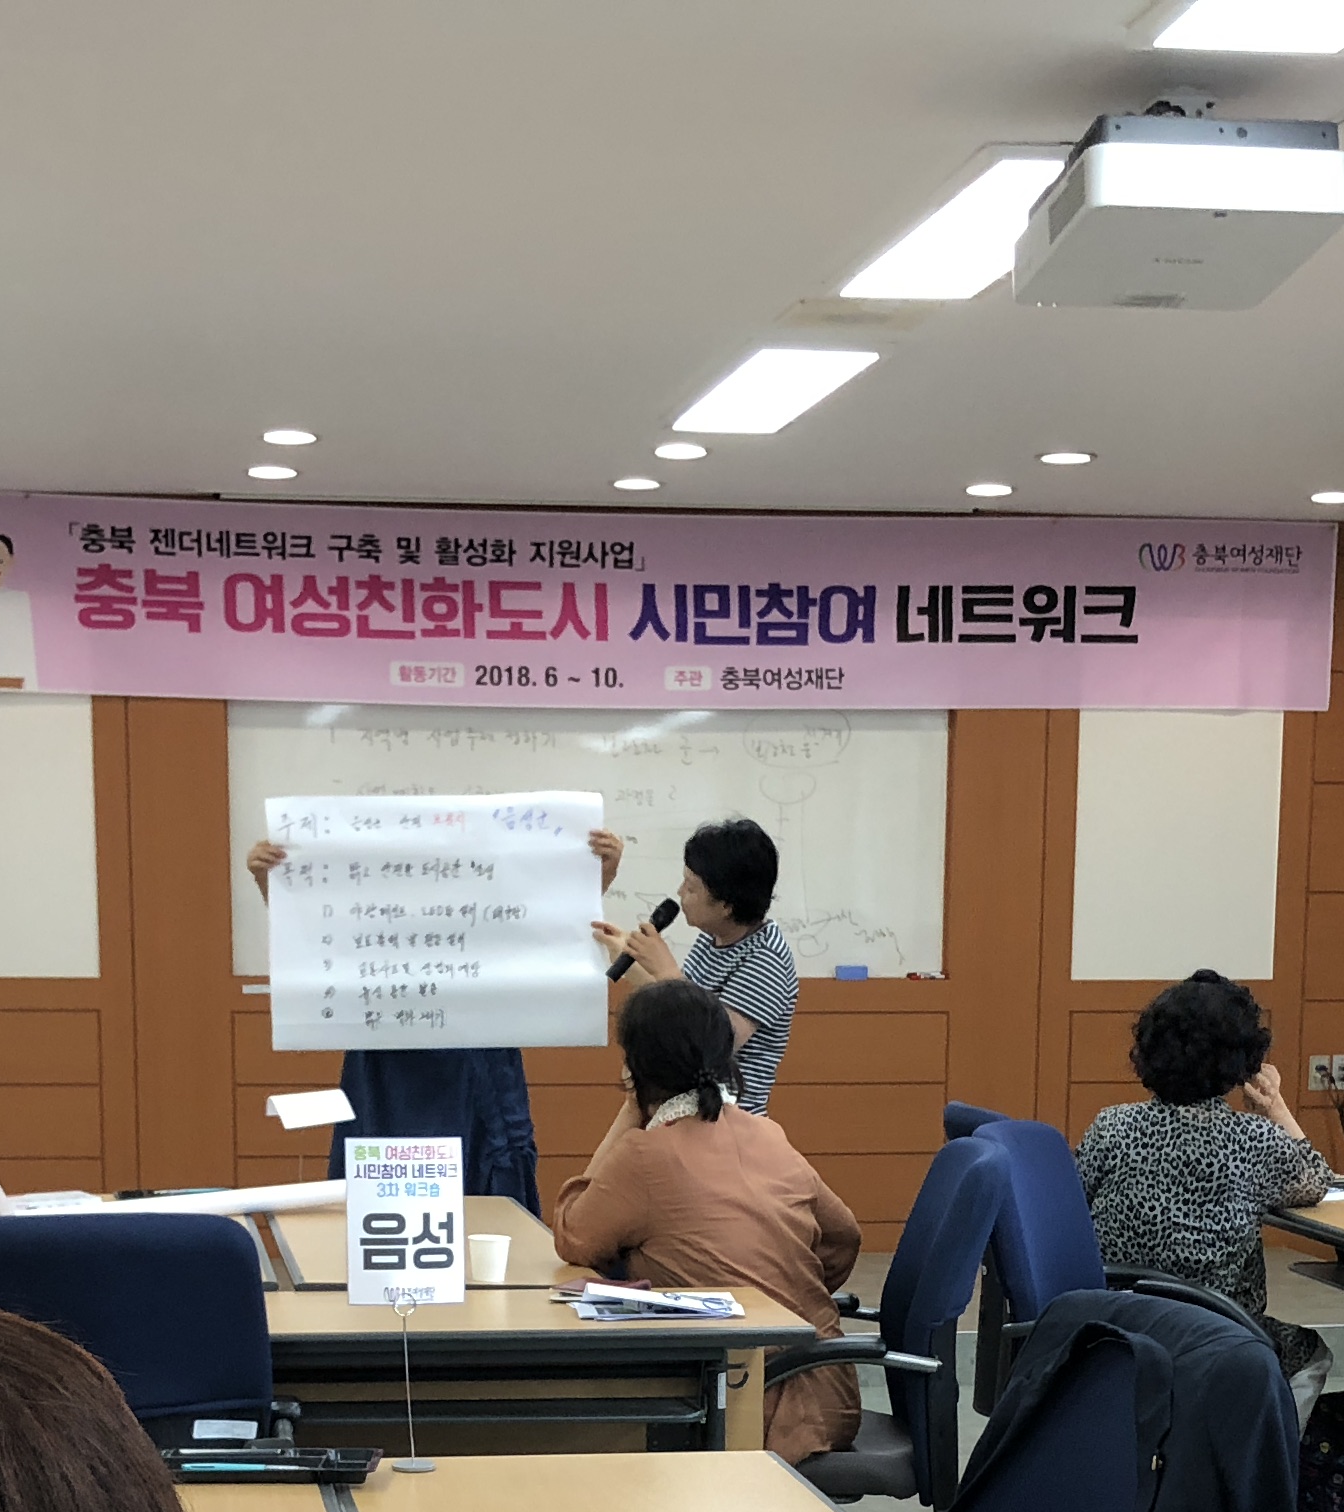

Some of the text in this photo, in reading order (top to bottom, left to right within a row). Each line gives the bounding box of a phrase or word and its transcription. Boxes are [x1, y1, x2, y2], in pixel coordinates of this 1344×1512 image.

[149, 527, 316, 560] 젠더네트워크
[328, 533, 383, 563] 구축
[396, 535, 421, 565] 및
[434, 536, 517, 568] 활성화
[1192, 543, 1303, 567] 충북여성재단
[74, 563, 1139, 646] 충북 여성친화도시 시민참여 네트워크
[398, 664, 457, 684] 활동기간
[474, 665, 537, 687] 2018.
[544, 666, 557, 687] 6
[590, 666, 624, 688] 10.
[674, 670, 703, 687] 주관
[720, 667, 845, 690] 충북여성재단
[354, 1145, 381, 1161] 충북
[354, 1163, 458, 1180] 시민참여 네트워크
[376, 1182, 441, 1198] 3차 워크숍
[359, 1211, 455, 1271] 음성
